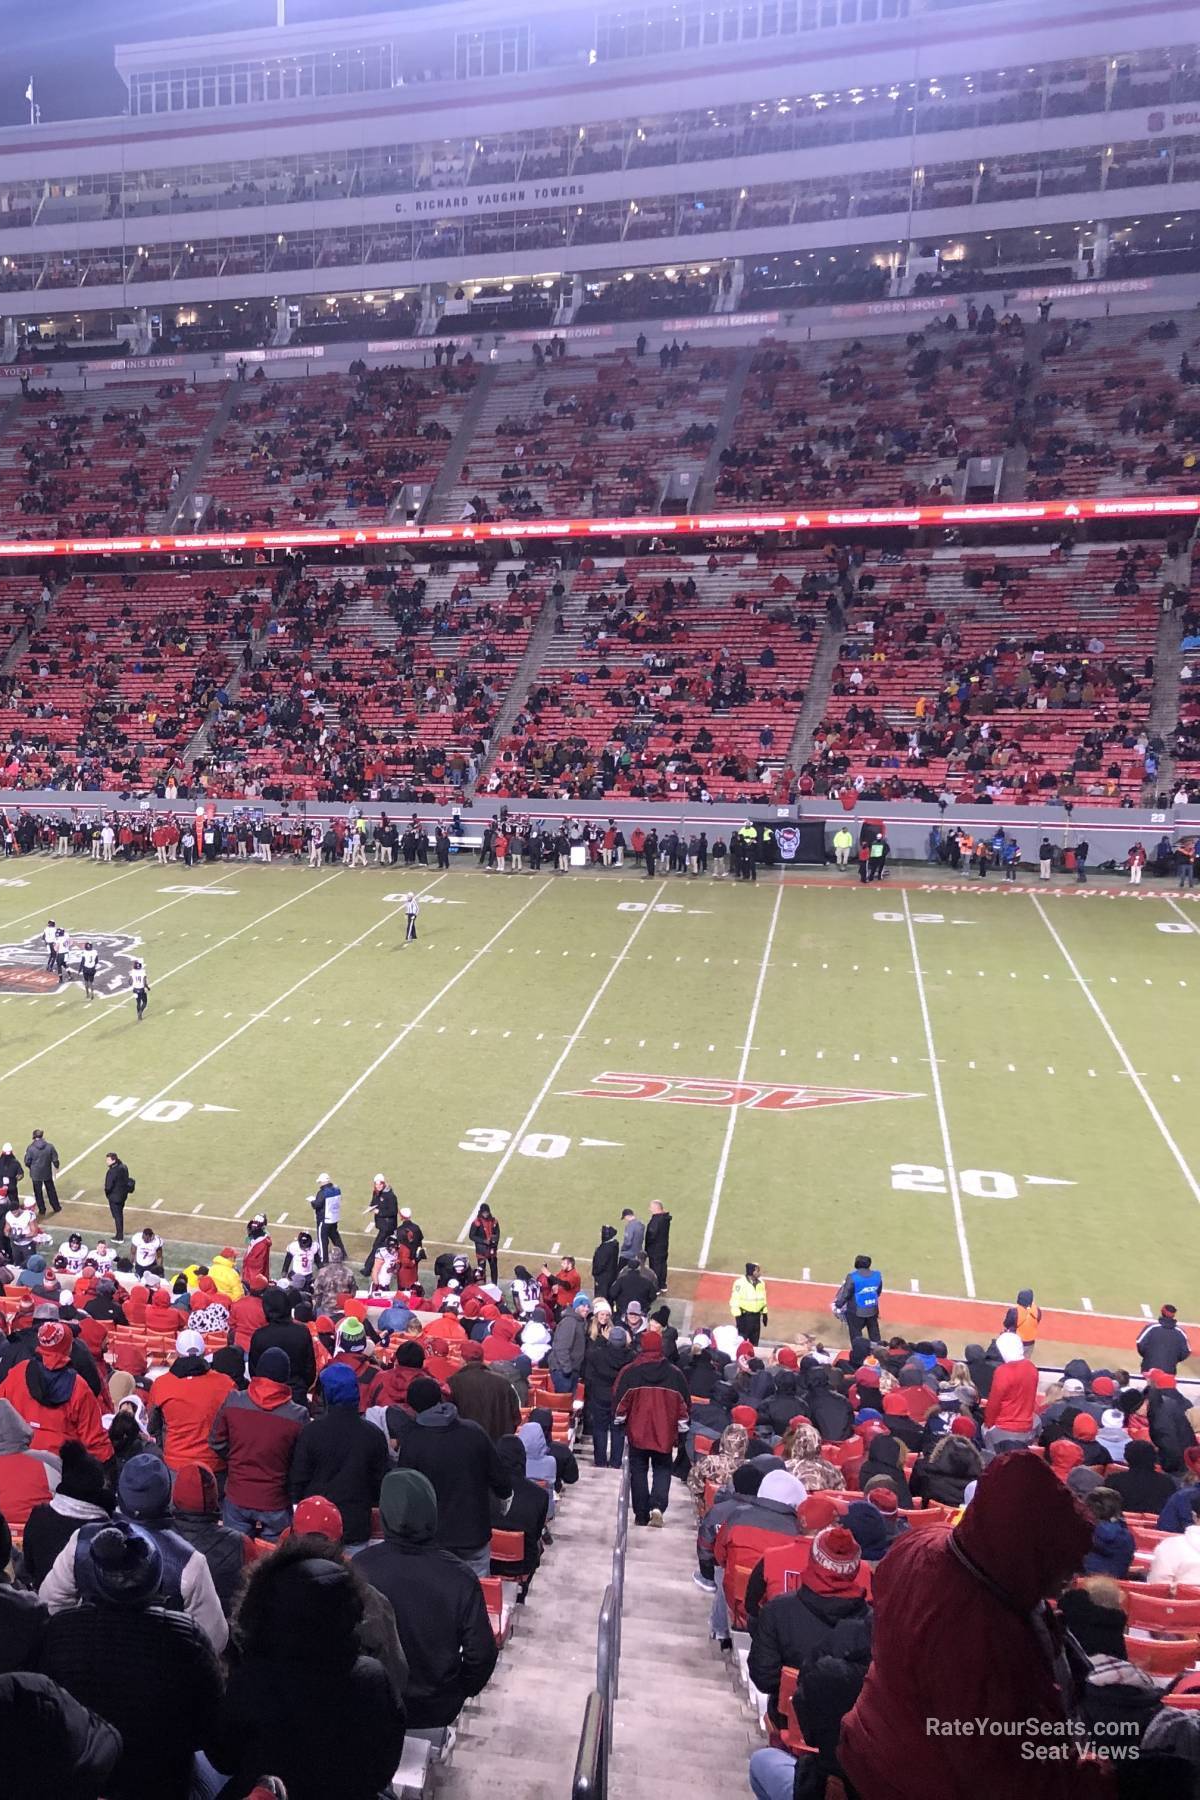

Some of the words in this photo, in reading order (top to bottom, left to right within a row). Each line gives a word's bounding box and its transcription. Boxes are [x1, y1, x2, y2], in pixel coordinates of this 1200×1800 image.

[395, 203, 407, 213] C.
[415, 196, 469, 212] RICHARD
[477, 190, 526, 205] VAUGHN
[534, 185, 585, 200] TOWERS
[912, 298, 947, 310] HOLT
[777, 808, 789, 817] 22
[1151, 813, 1165, 823] 23
[93, 1094, 195, 1123] 40
[457, 1126, 572, 1160] 30
[890, 1163, 1021, 1200] 20
